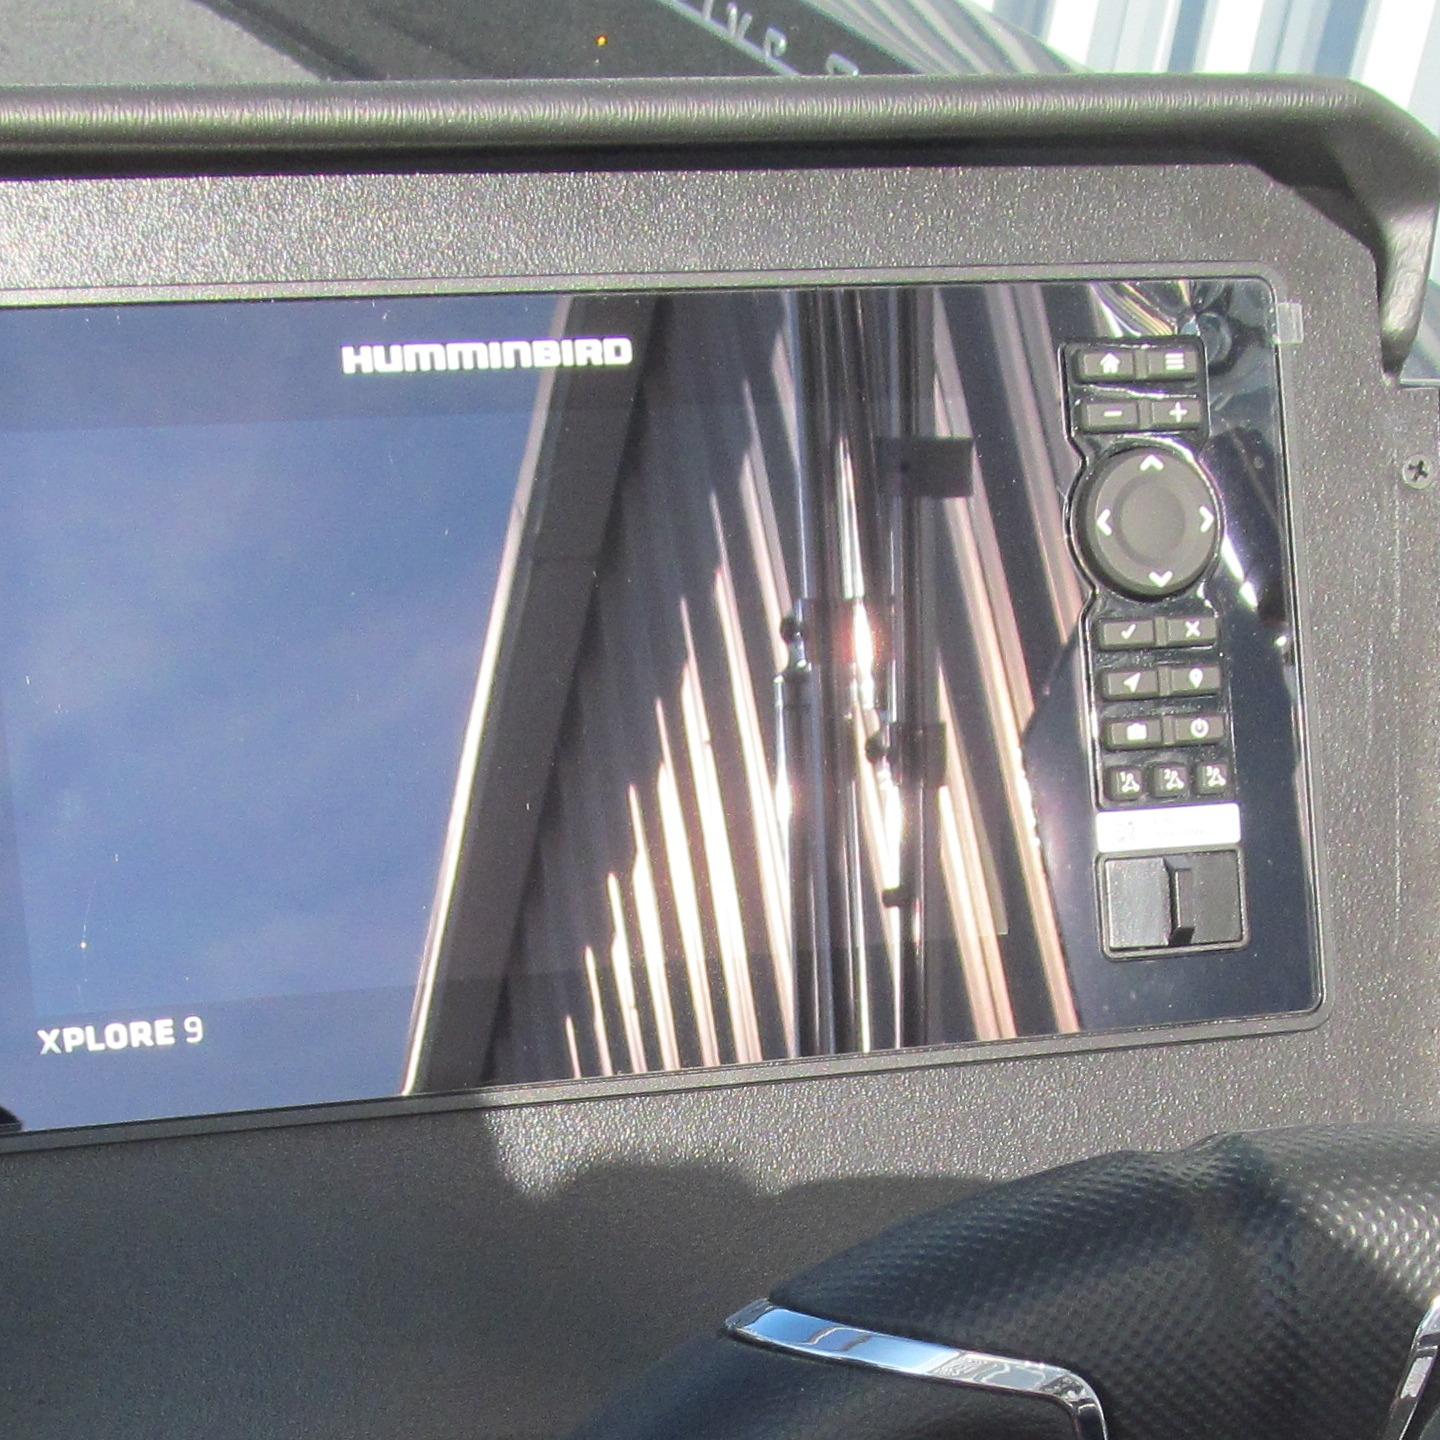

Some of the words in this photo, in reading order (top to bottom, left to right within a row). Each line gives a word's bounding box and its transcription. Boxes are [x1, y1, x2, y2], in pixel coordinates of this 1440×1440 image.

[341, 337, 633, 374] HUMMINBIRD
[37, 1018, 176, 1055] XPLORE
[183, 1015, 204, 1044] 9
